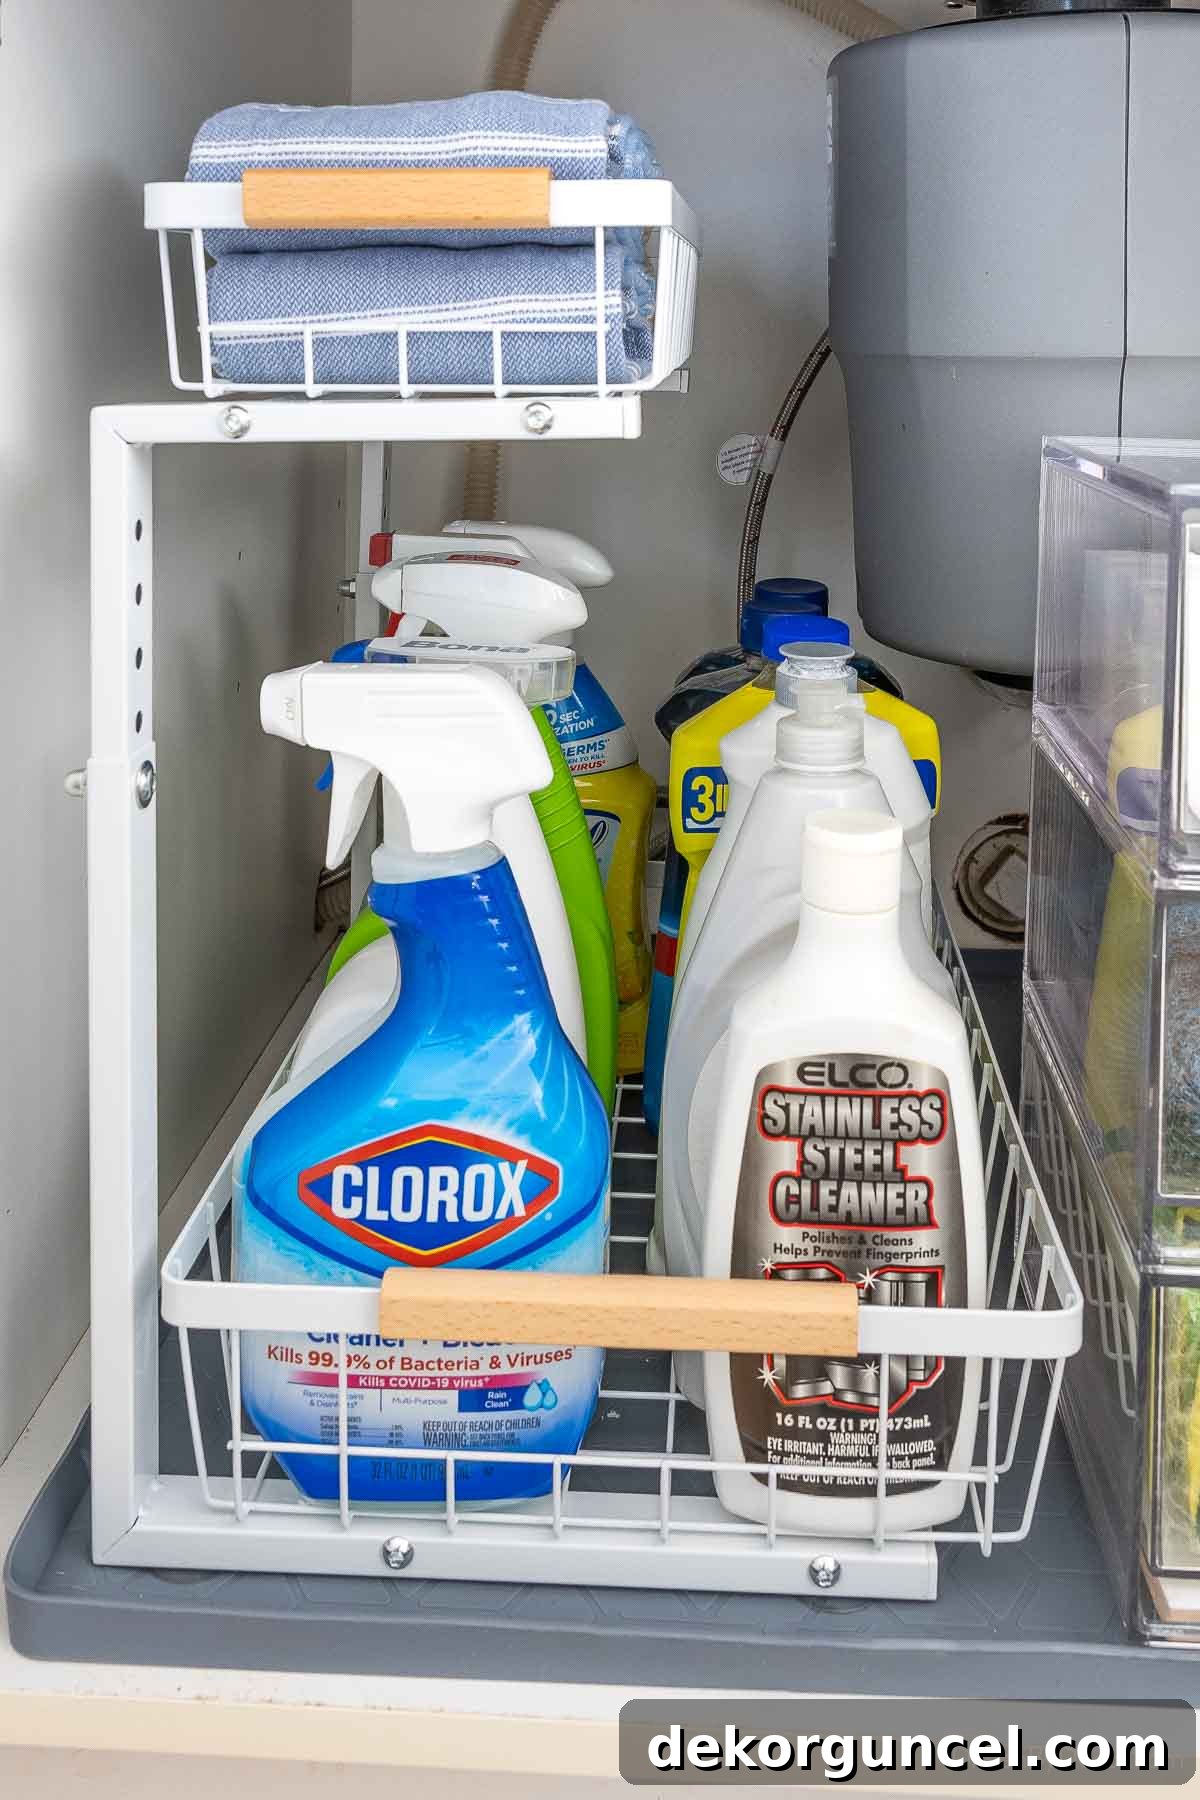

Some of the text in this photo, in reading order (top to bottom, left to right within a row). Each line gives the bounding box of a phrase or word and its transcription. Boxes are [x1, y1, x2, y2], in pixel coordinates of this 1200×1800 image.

[401, 640, 530, 653] Bona
[560, 711, 581, 723] SEC
[763, 1091, 942, 1141] STAINLESS
[803, 1138, 905, 1181] STEEL
[331, 1159, 529, 1223] CLOROX
[775, 1176, 930, 1225] CLEANER
[802, 1232, 914, 1247] Polishes & Cleans
[773, 1243, 941, 1262] Helps Prevent Fingerprints
[267, 1345, 303, 1364] Kills
[376, 1356, 396, 1371] of
[489, 1355, 502, 1370] &
[359, 1376, 385, 1387] Kills
[389, 1377, 449, 1388] COVID-19
[488, 1391, 507, 1399] Rain
[423, 1416, 541, 1432] KEEP OUT OF REACH OF CHILDREN
[776, 1412, 794, 1426] 16
[798, 1416, 812, 1429] FL
[816, 1417, 837, 1430] OZ
[840, 1418, 854, 1432] (1
[887, 1414, 931, 1431] 473mL
[767, 1436, 782, 1450] EYE
[784, 1439, 826, 1456] IRRITANT.
[828, 1443, 870, 1457] HARMFUL
[886, 1440, 937, 1456] WALLOWED.
[830, 1431, 876, 1445] WARNING!
[768, 1451, 782, 1464] For
[892, 1456, 911, 1469] back
[912, 1452, 936, 1471] panel.
